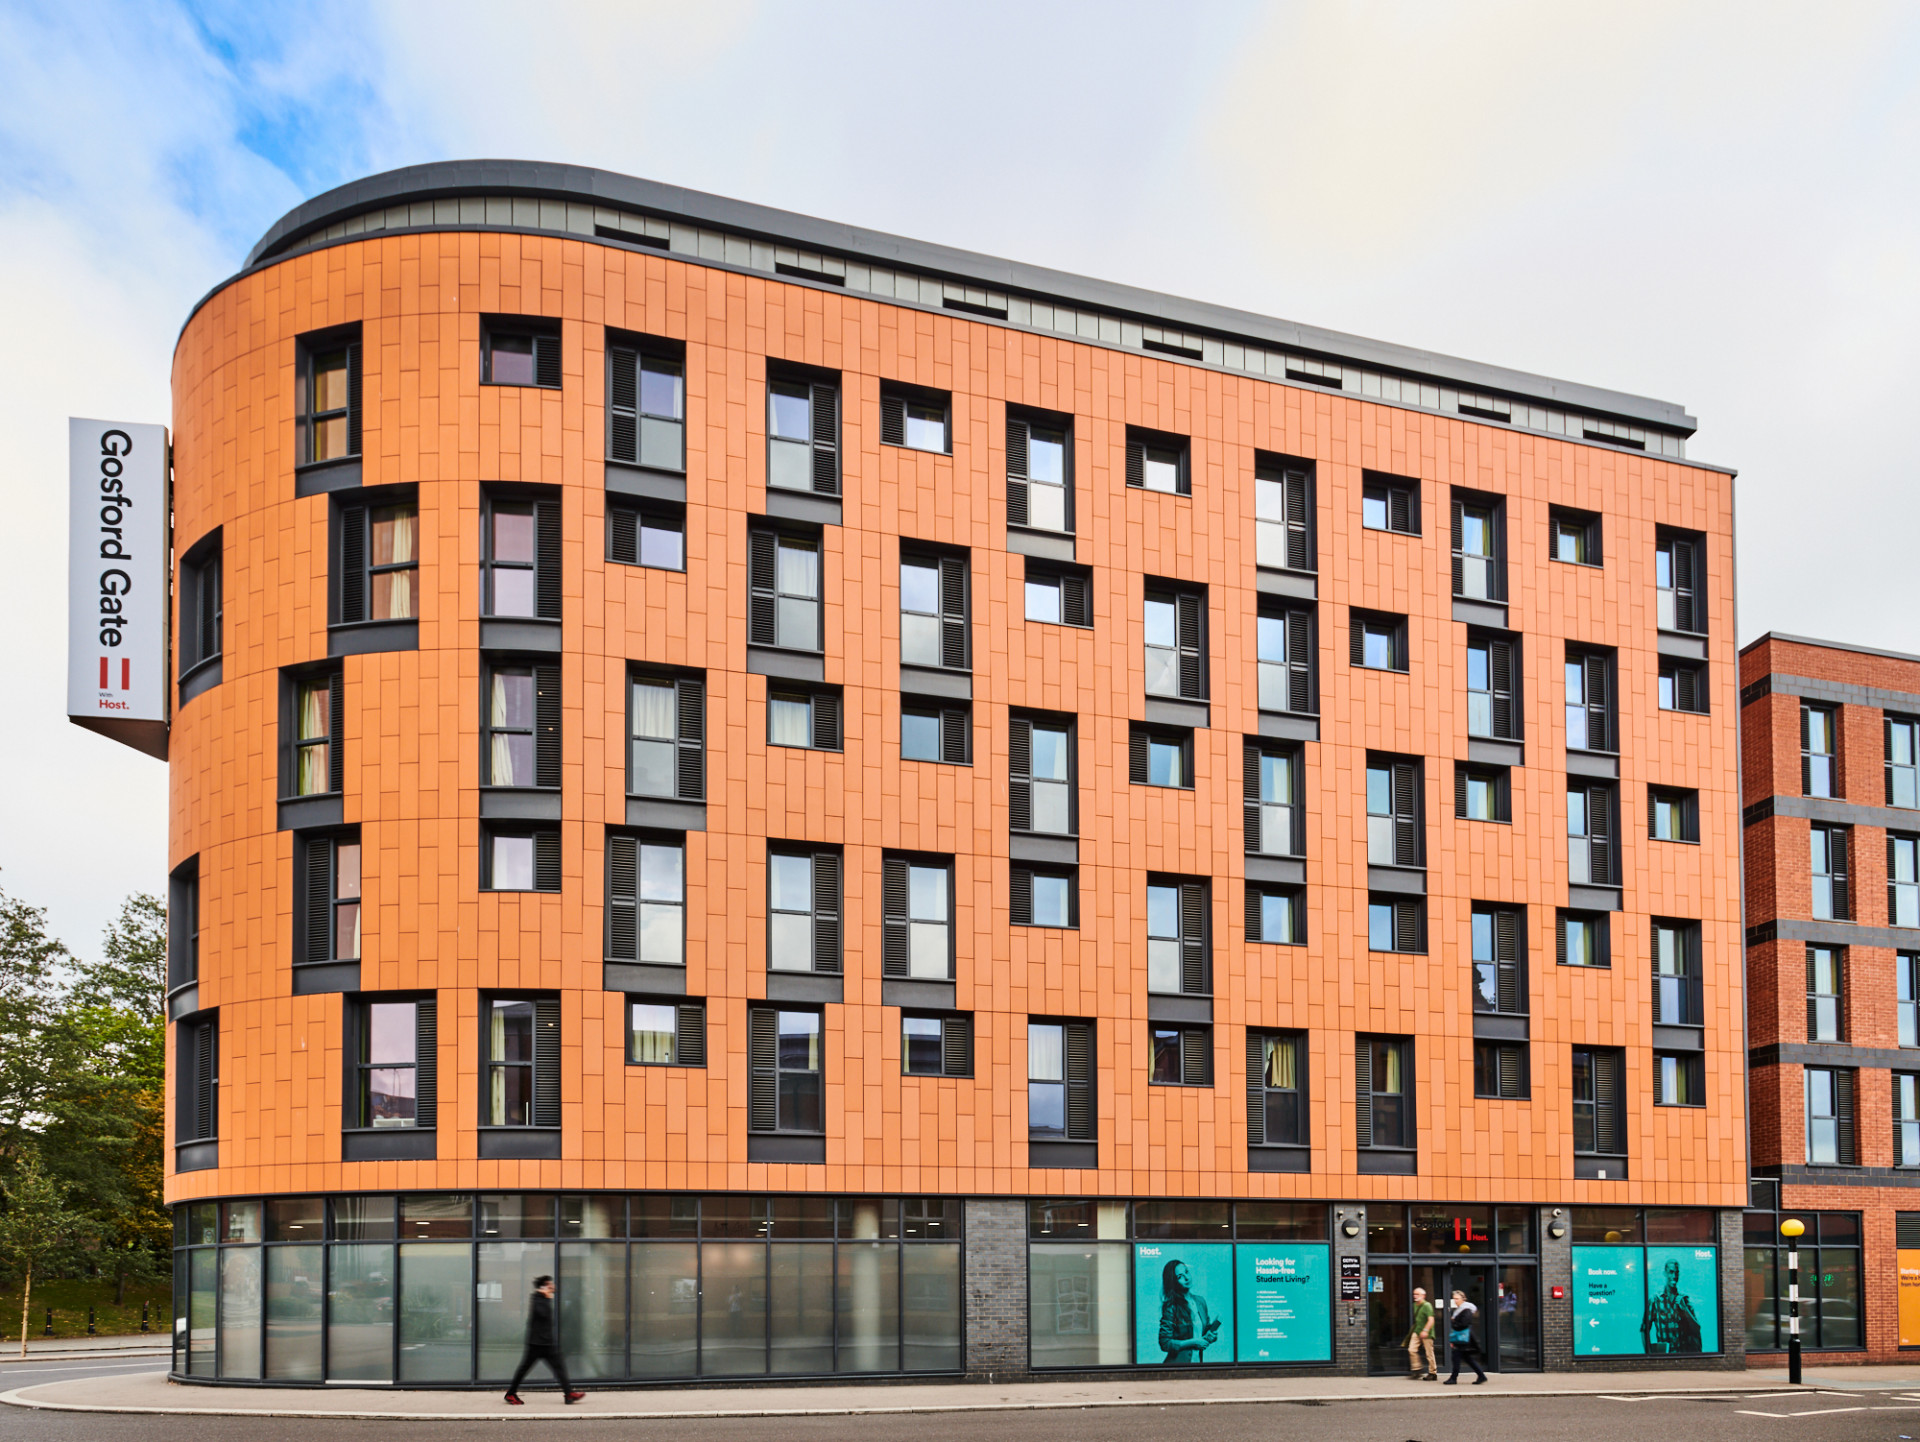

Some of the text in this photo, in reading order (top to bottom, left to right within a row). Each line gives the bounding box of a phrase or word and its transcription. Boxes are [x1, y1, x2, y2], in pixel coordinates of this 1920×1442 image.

[99, 429, 132, 647] Gosford Gate
[99, 699, 130, 710] Host.
[1415, 1218, 1453, 1228] Gosford
[1140, 1247, 1162, 1255] Host.
[1695, 1249, 1712, 1258] Host.
[1256, 1257, 1296, 1267] Looking for
[1256, 1266, 1295, 1274] Hassle-free
[1256, 1275, 1310, 1284] Student Living?
[1588, 1289, 1616, 1297] question?
[1589, 1297, 1600, 1305] Pop
